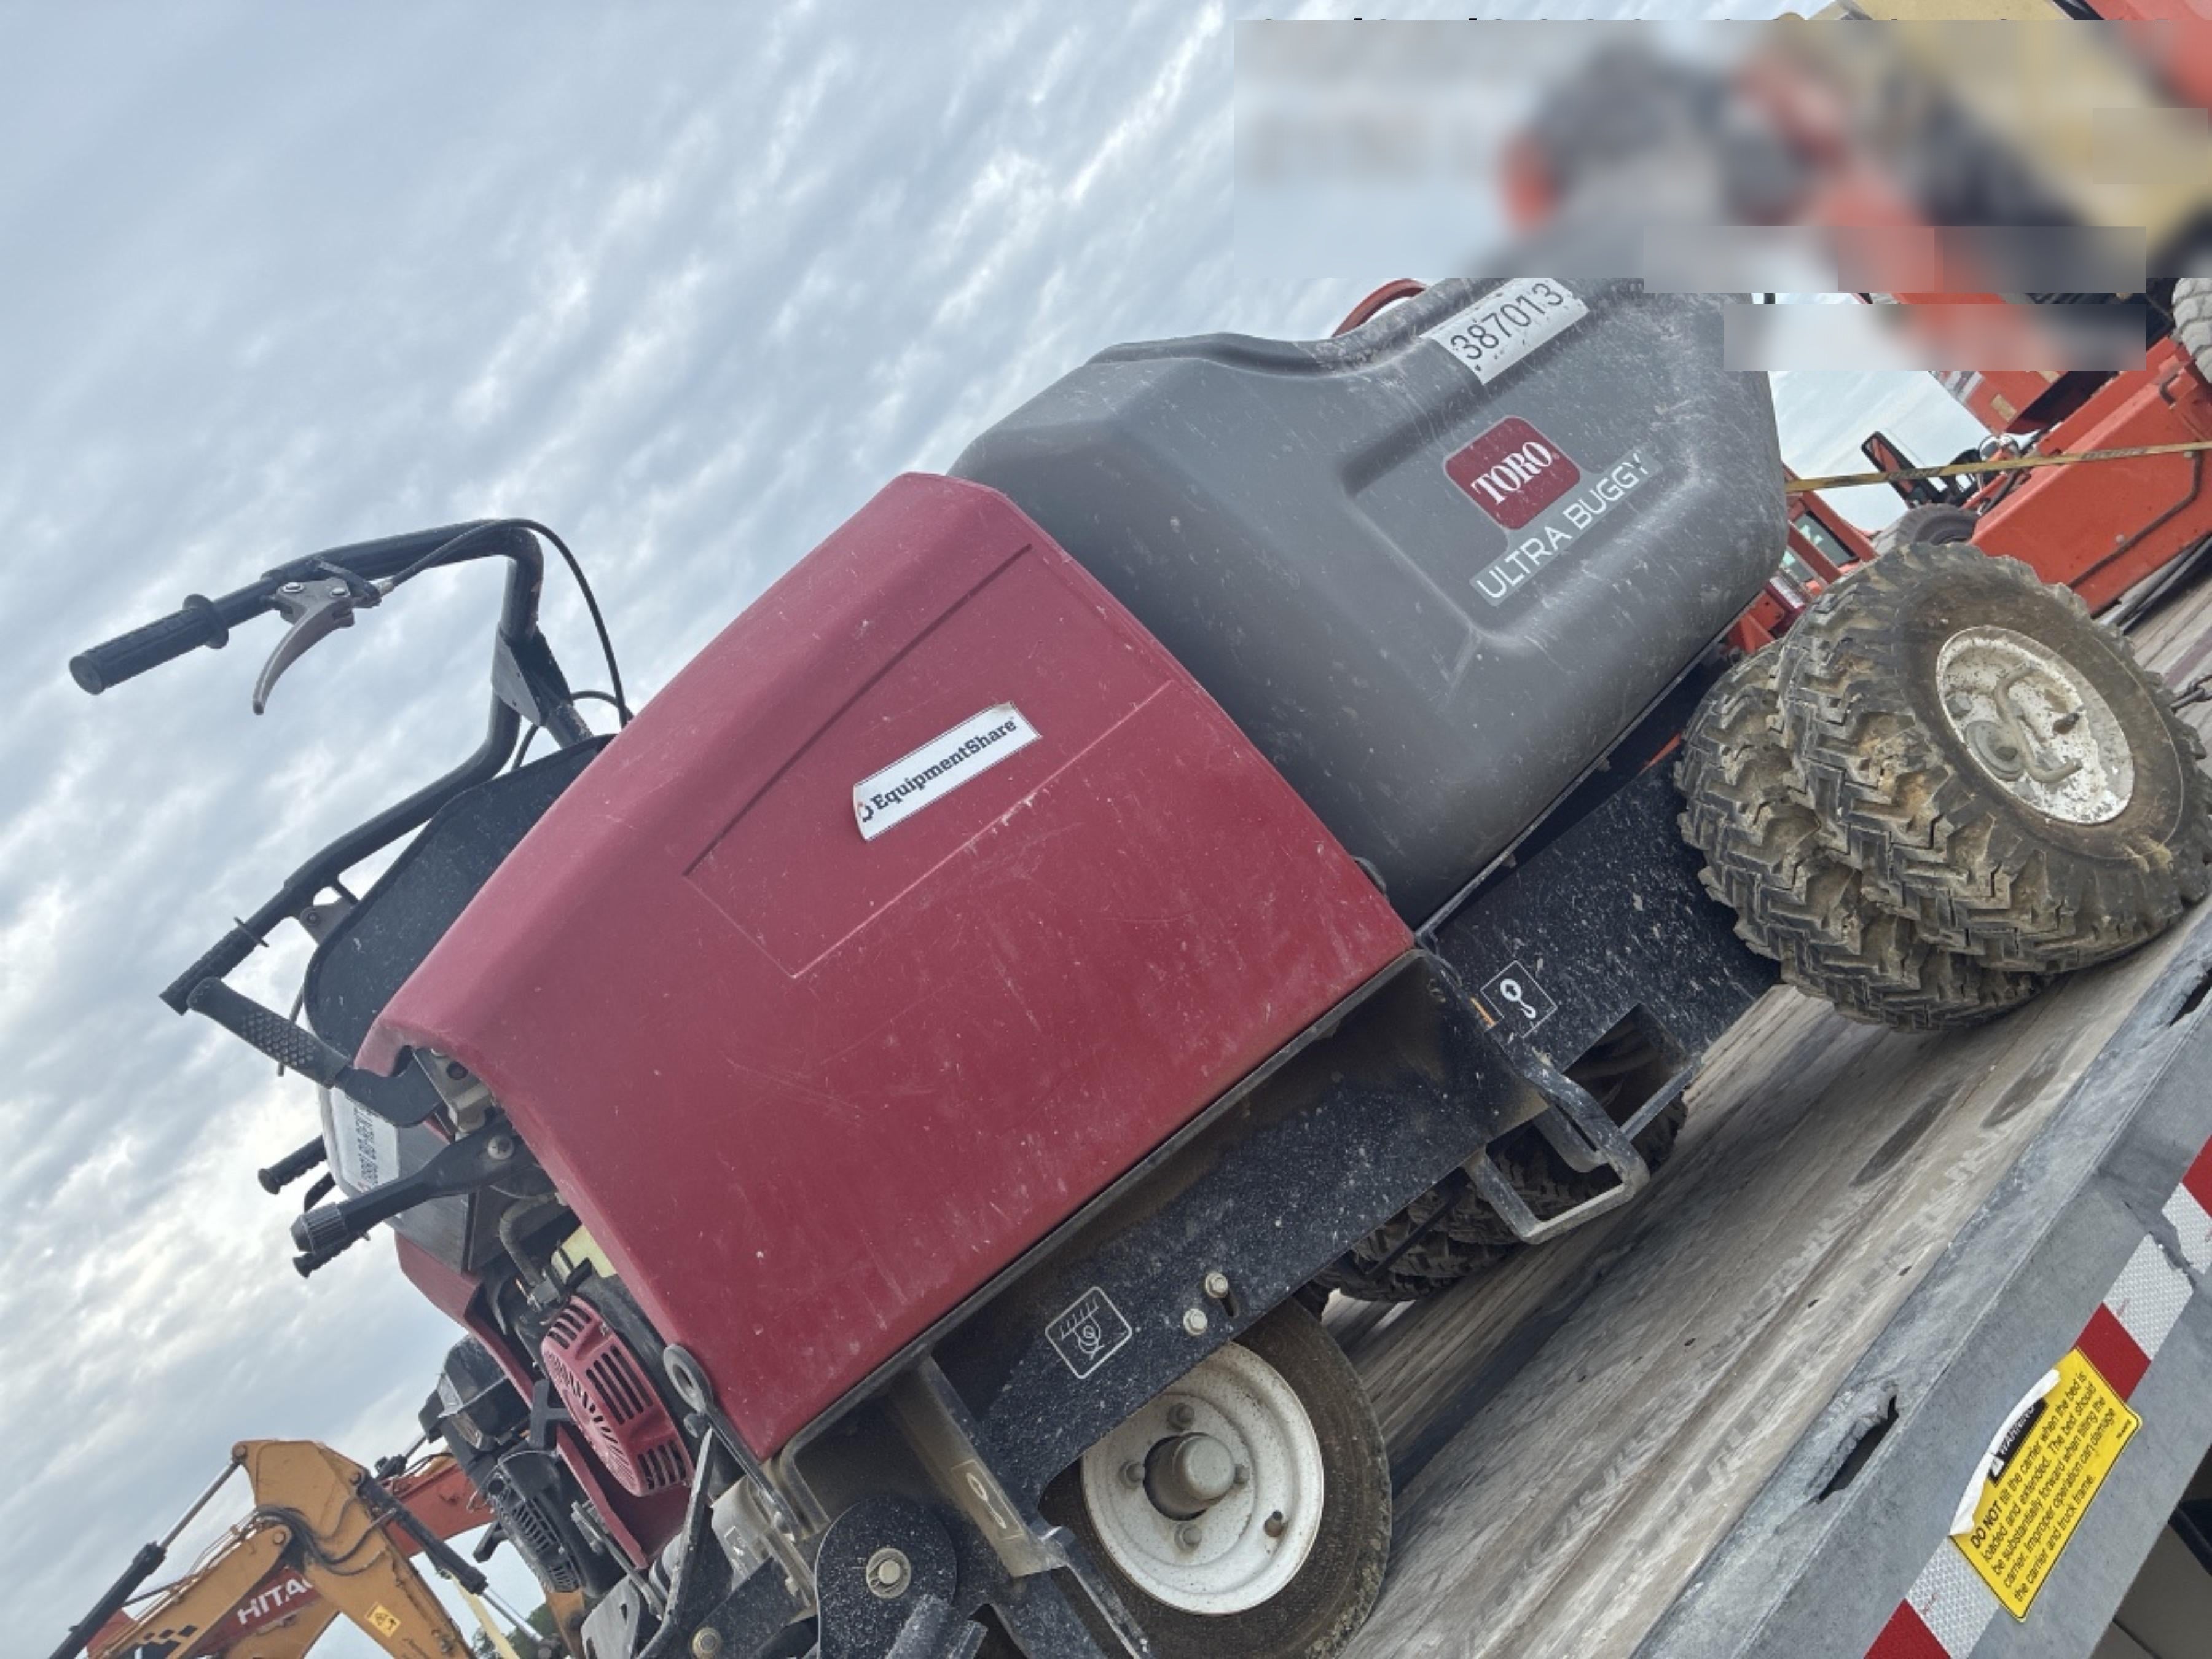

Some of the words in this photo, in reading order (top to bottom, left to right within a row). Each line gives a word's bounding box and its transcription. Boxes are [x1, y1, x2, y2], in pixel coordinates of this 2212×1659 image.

[1451, 284, 1563, 359] 387013
[1471, 442, 1552, 504] TORO
[1477, 527, 1572, 597] ULTRA
[1563, 451, 1648, 530] BUGGY
[870, 721, 1016, 810] EquipmentShare
[1970, 1527, 1986, 1548] DO
[1983, 1500, 2002, 1530] NOT
[1999, 1489, 2012, 1504] tilt
[2007, 1473, 2022, 1491] the
[2020, 1441, 2042, 1475] carrier
[2041, 1416, 2059, 1442] when
[2055, 1400, 2068, 1417] the
[2065, 1379, 2081, 1401] bed
[2076, 1371, 2087, 1382] is
[1980, 1523, 2007, 1563] loaded
[2006, 1501, 2021, 1526] and
[2047, 1435, 2065, 1454] The
[2061, 1413, 2077, 1436] bed
[2076, 1381, 2096, 1416] should
[1991, 1559, 2005, 1575] be
[2002, 1497, 2044, 1561] substantially
[2039, 1460, 2065, 1500] forward
[2063, 1435, 2081, 1462] when
[2092, 1396, 2105, 1413] the
[2024, 1505, 2055, 1553] Improper
[2053, 1462, 2083, 1508] operation
[2080, 1444, 2095, 1464] can
[2090, 1408, 2115, 1445] damage
[2014, 1583, 2028, 1602] the
[2026, 1548, 2048, 1584] carrier
[2047, 1526, 2061, 1550] and
[2057, 1503, 2077, 1530] truck
